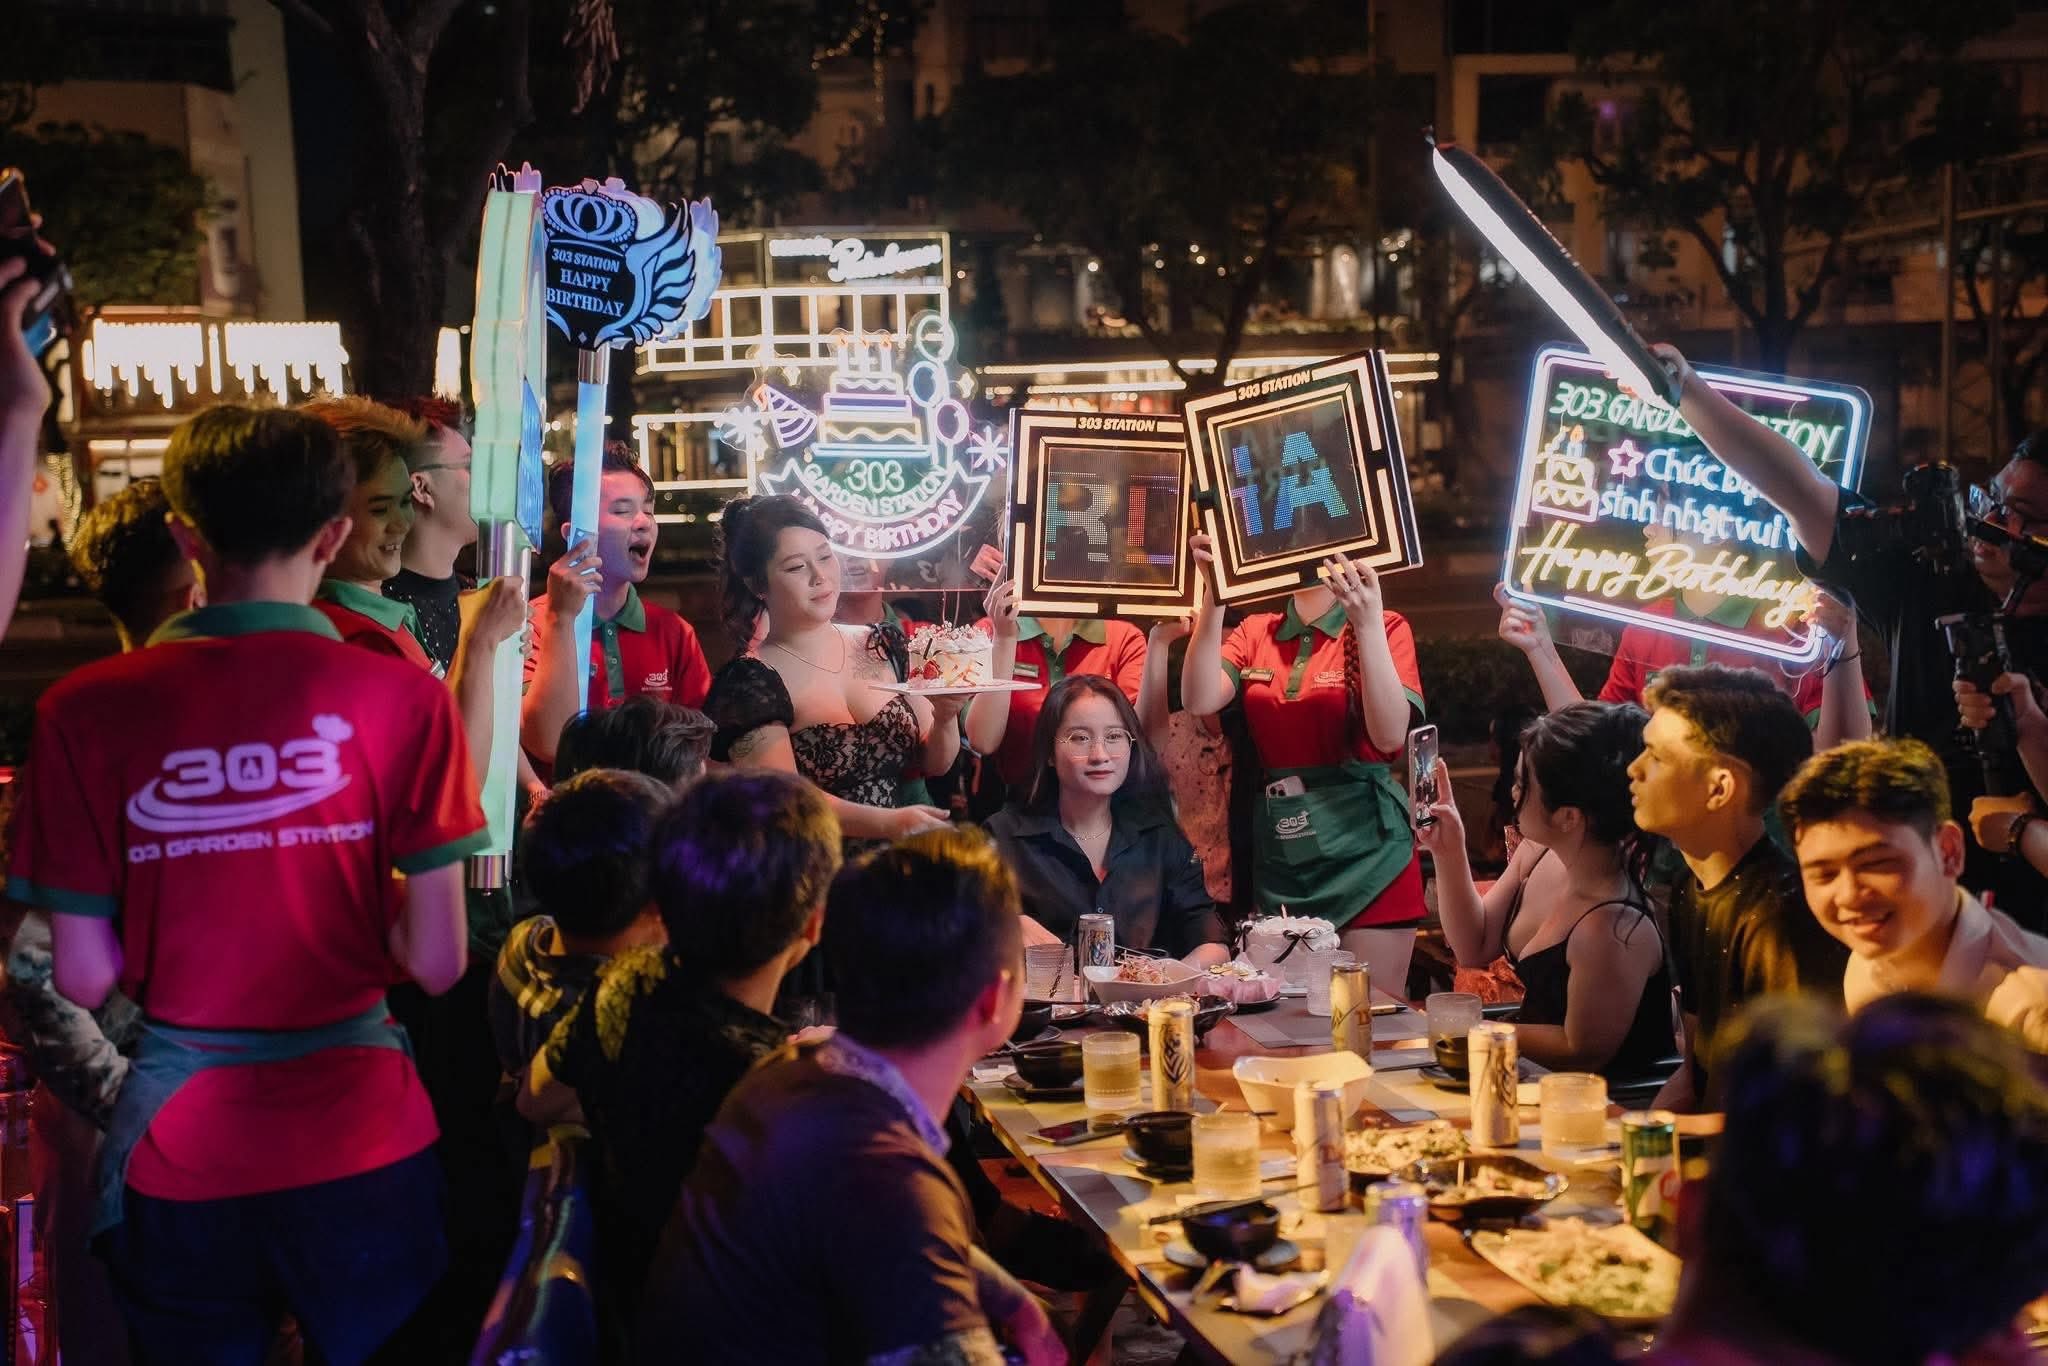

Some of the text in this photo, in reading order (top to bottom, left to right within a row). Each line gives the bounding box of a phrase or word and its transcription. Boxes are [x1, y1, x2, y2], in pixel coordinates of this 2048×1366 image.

[552, 248, 620, 273] 303 STATION
[560, 267, 612, 293] HAPPY
[546, 287, 624, 318] BIRTHDAY
[1238, 369, 1311, 401] 303 STATION
[1549, 381, 1608, 420] 303
[1078, 416, 1156, 432] 303 STATION
[802, 463, 947, 516] GARDEN STATION
[847, 459, 905, 494] 303
[863, 488, 964, 550] BIRTHDAY
[1598, 484, 1658, 523] sinh
[1735, 513, 1784, 549] vui
[1521, 520, 1813, 628] Happy Birthday
[648, 672, 669, 682] 303
[162, 738, 342, 799] 303
[129, 819, 374, 864] 03 GARDEN STATION
